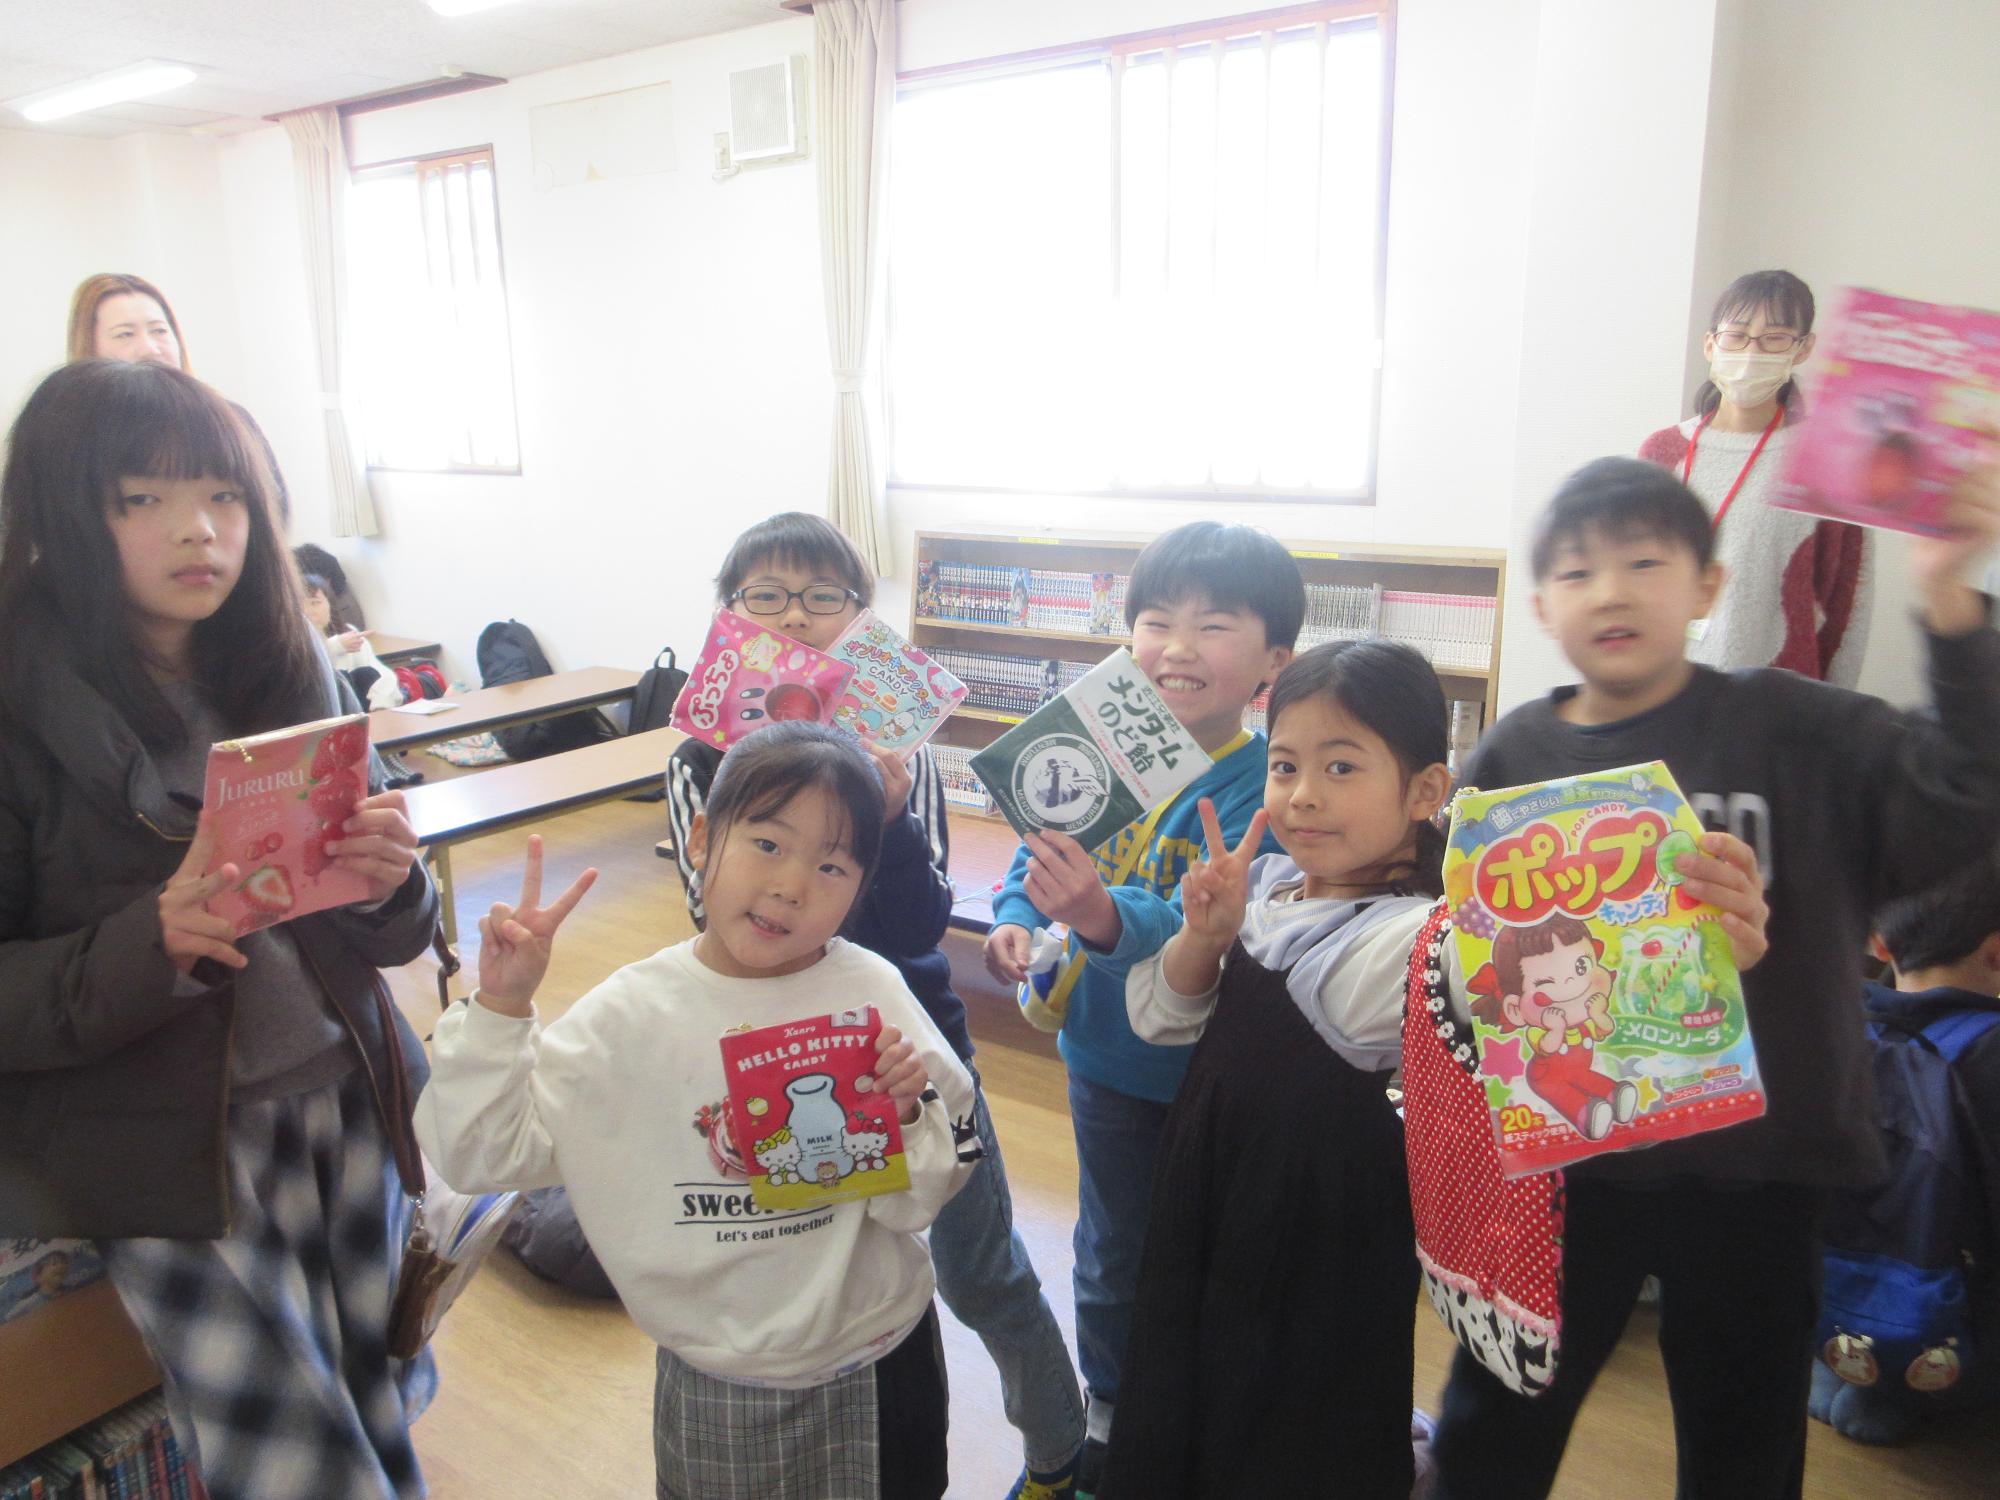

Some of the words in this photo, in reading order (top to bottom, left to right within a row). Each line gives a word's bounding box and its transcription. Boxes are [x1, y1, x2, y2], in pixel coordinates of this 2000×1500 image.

[691, 651, 736, 727] ぷっちょ
[869, 666, 908, 697] CANDY
[1098, 701, 1156, 775] のど飴
[1107, 675, 1183, 771] メンターム
[1490, 796, 1561, 831] 歯にやさしい
[1570, 815, 1587, 837] POP
[1586, 801, 1626, 819] CANDY
[1486, 820, 1660, 910] ポップ
[1599, 892, 1665, 923] キャンディ
[1623, 1022, 1722, 1047] メロンソーダ
[737, 1042, 802, 1073] HELLO
[806, 1034, 870, 1052] KITTY
[783, 1053, 828, 1071] CANDY
[807, 1135, 833, 1145] MILK
[716, 1231, 748, 1243] Let's
[752, 1229, 775, 1241] eat
[779, 1213, 836, 1239] together
